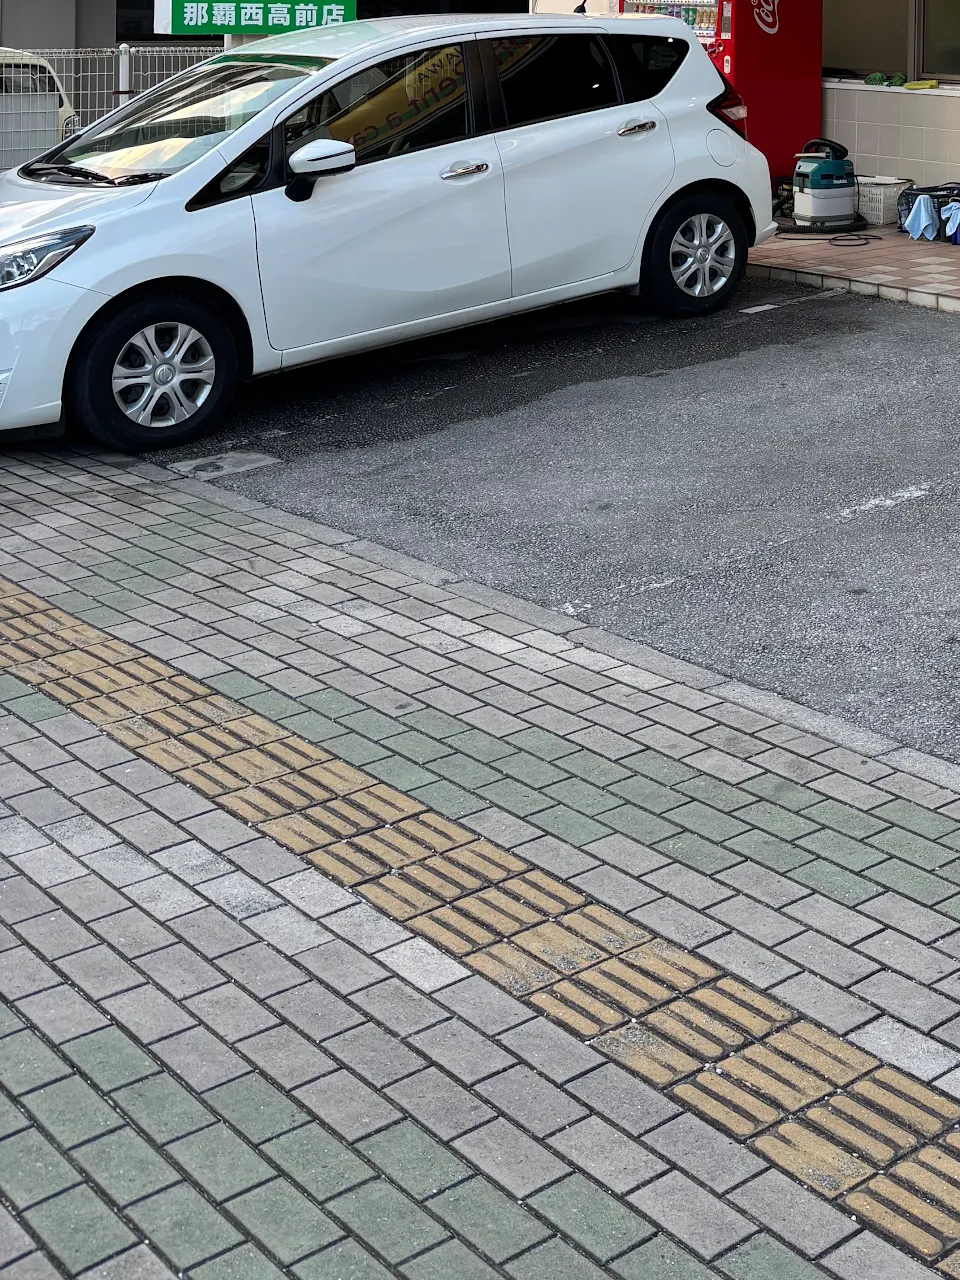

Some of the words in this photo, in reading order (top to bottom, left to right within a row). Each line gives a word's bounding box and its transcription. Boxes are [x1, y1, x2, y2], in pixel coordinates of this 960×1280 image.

[183, 2, 345, 26] 那覇西高前店
